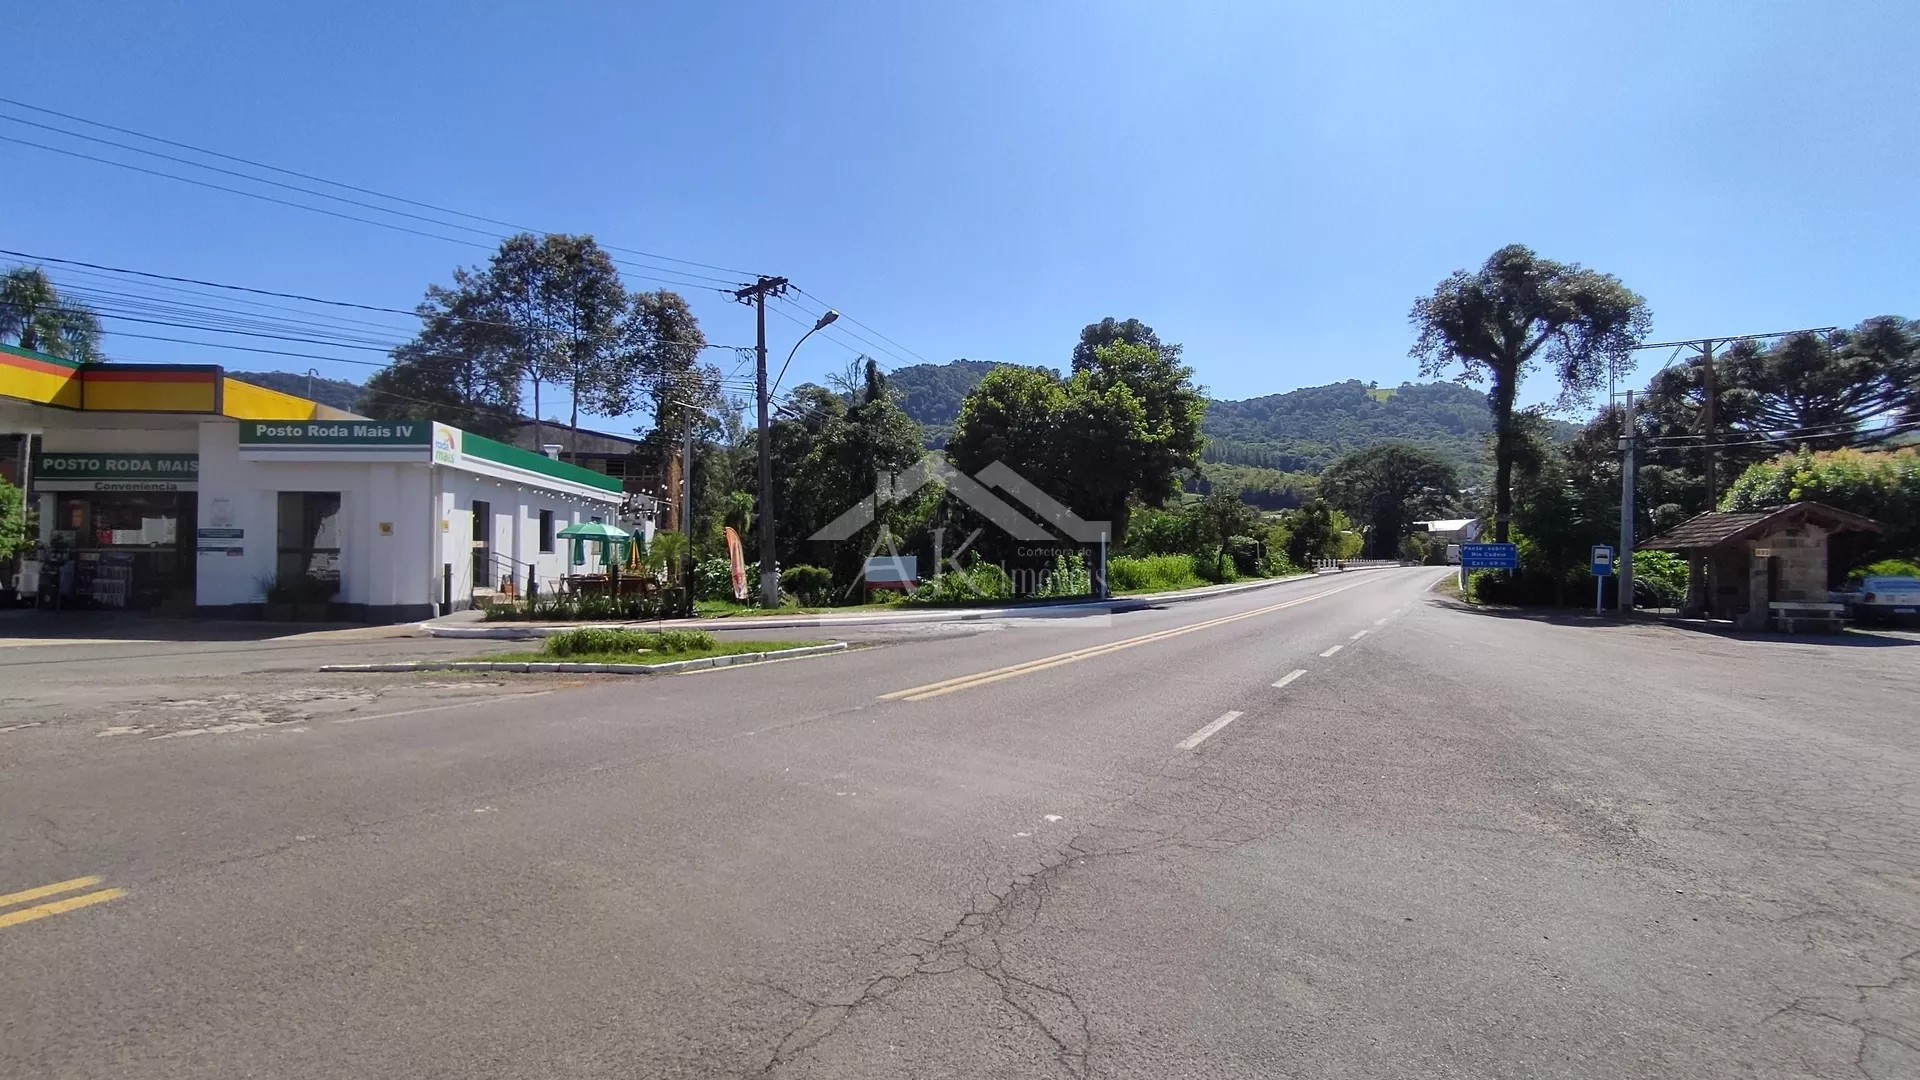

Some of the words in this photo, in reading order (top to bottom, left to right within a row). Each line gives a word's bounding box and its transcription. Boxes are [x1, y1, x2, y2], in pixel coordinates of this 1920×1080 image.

[256, 424, 302, 437] Posto
[307, 424, 348, 437] Roda
[353, 424, 392, 437] Mais
[396, 424, 413, 437] IV
[43, 458, 100, 470] POSTO
[106, 459, 152, 471] RODA
[157, 460, 199, 472] MAIS
